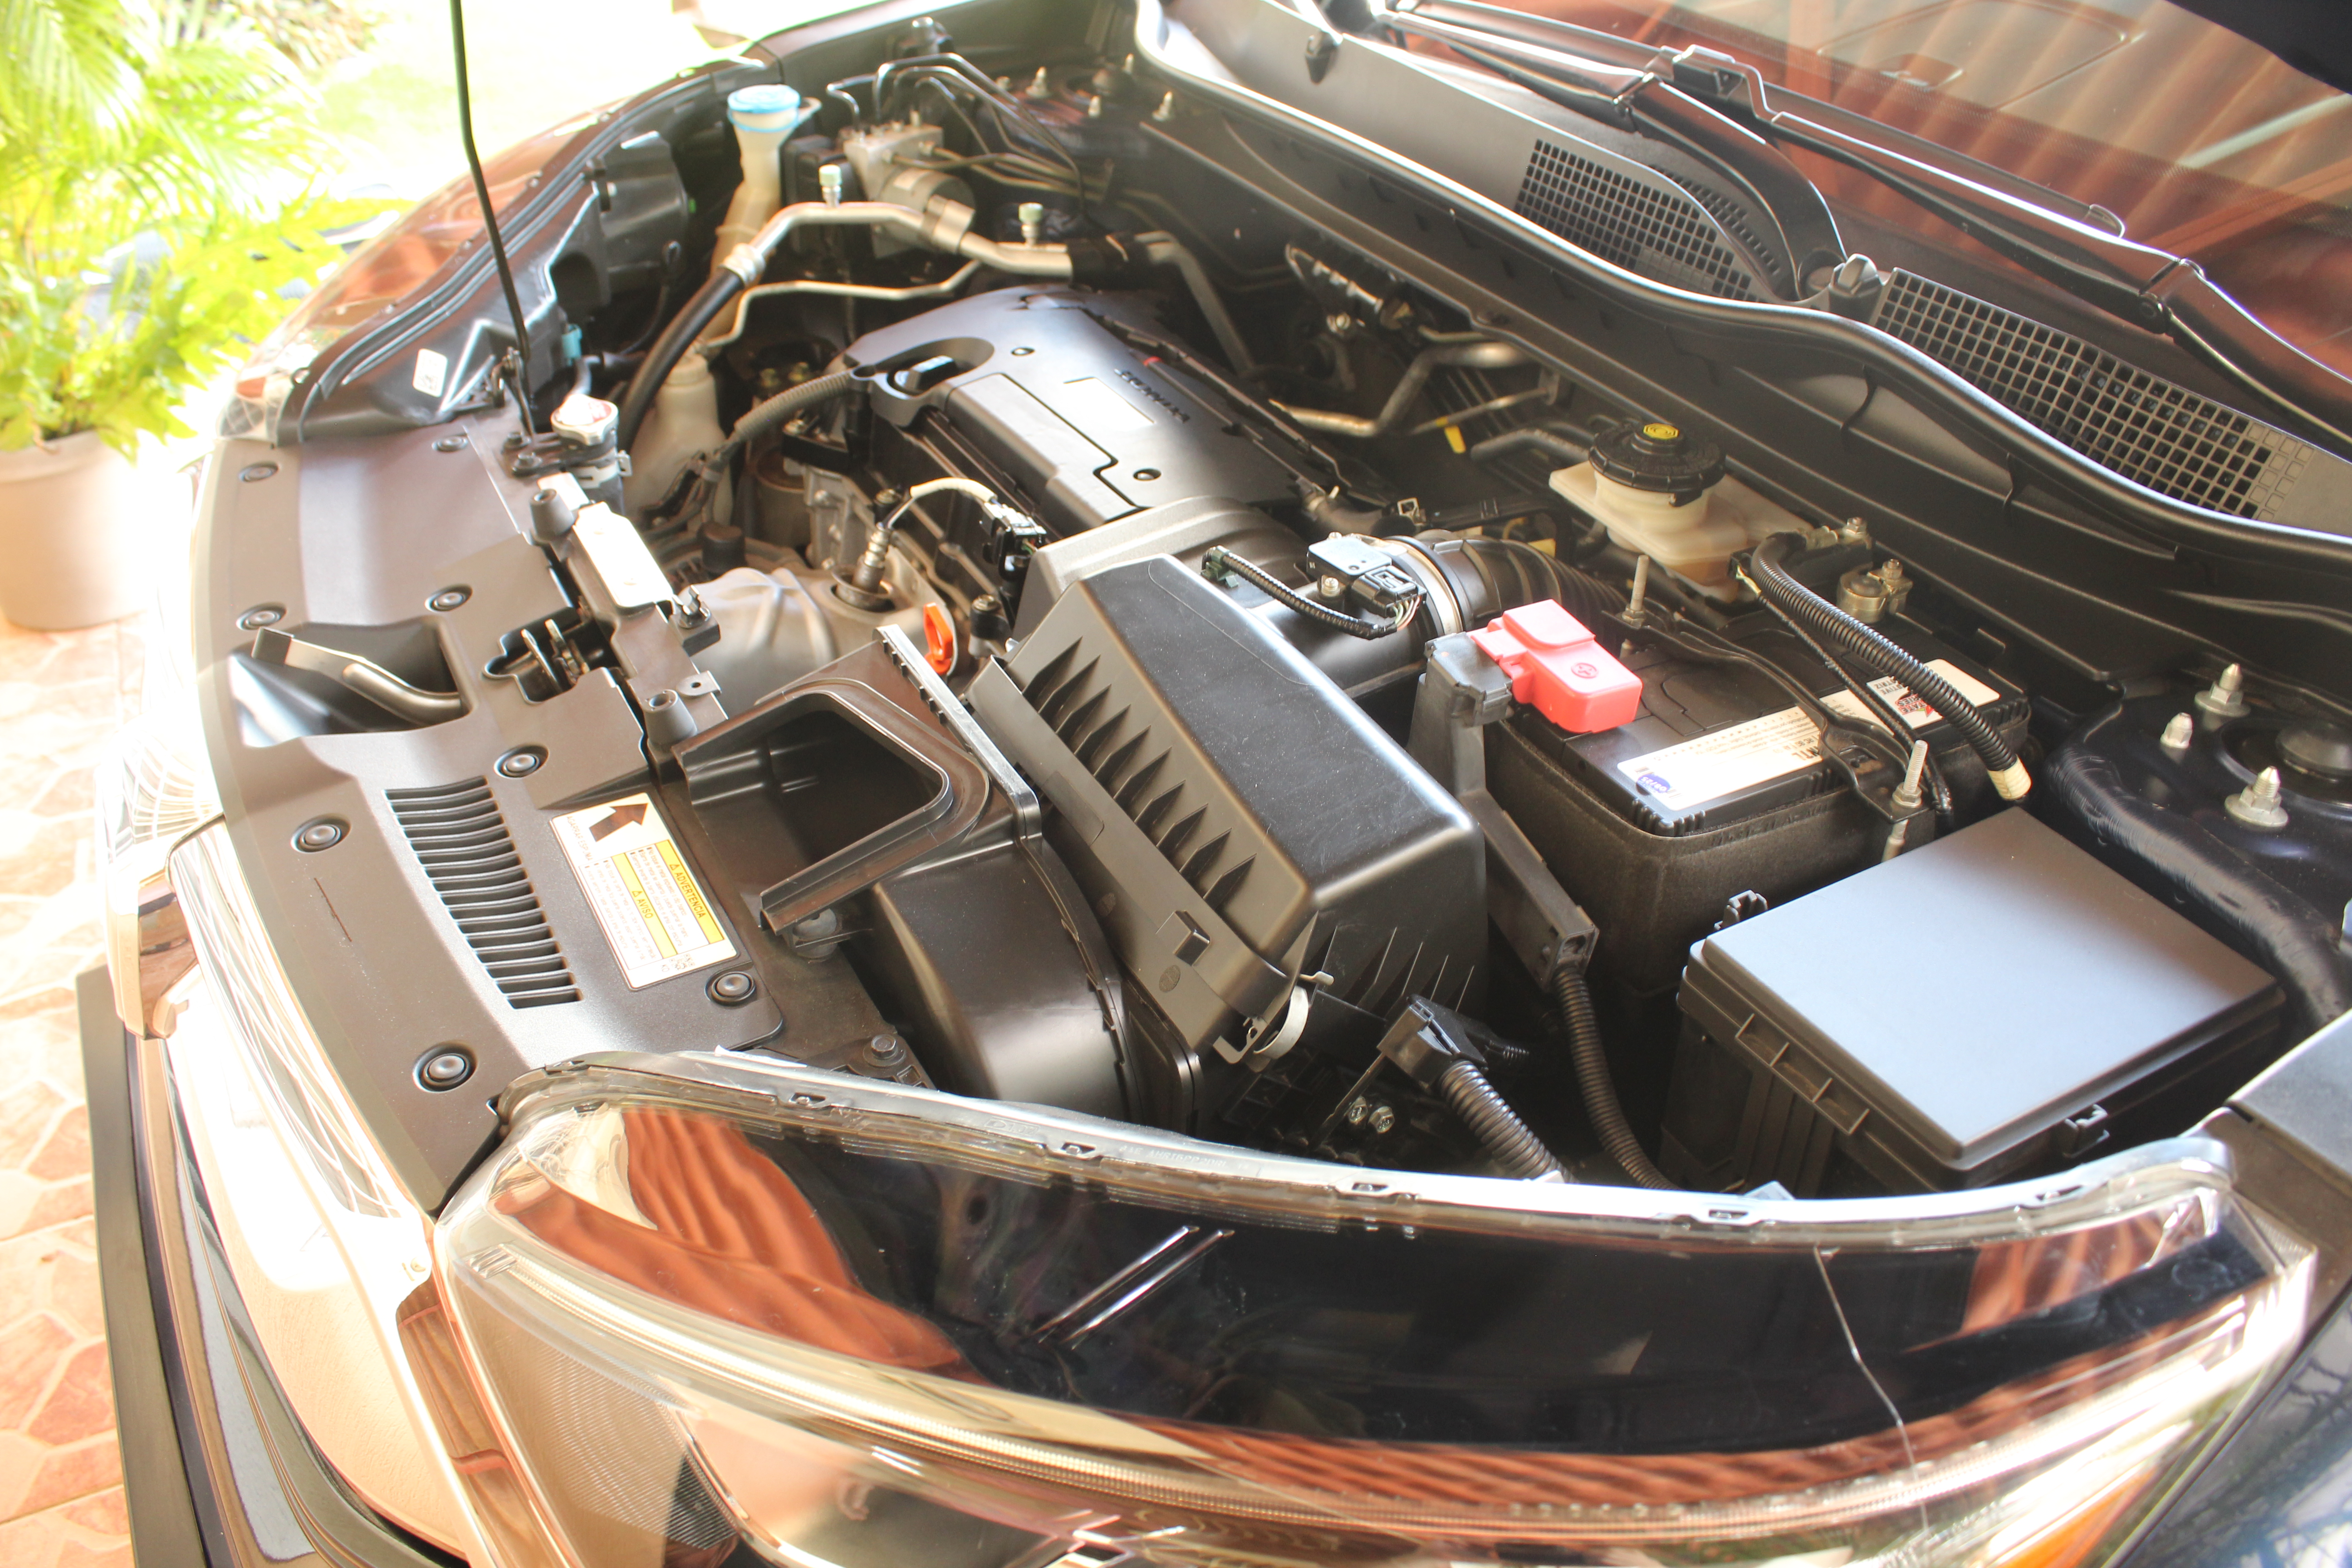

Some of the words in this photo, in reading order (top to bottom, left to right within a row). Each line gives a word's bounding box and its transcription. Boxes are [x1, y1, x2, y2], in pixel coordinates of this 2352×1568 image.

[1641, 776, 1667, 791] 08/25
[565, 815, 583, 840] AGARRAR
[577, 839, 594, 862] ESPUMA
[636, 897, 655, 919] AVISO
[674, 871, 707, 918] ADVERTENCIA
